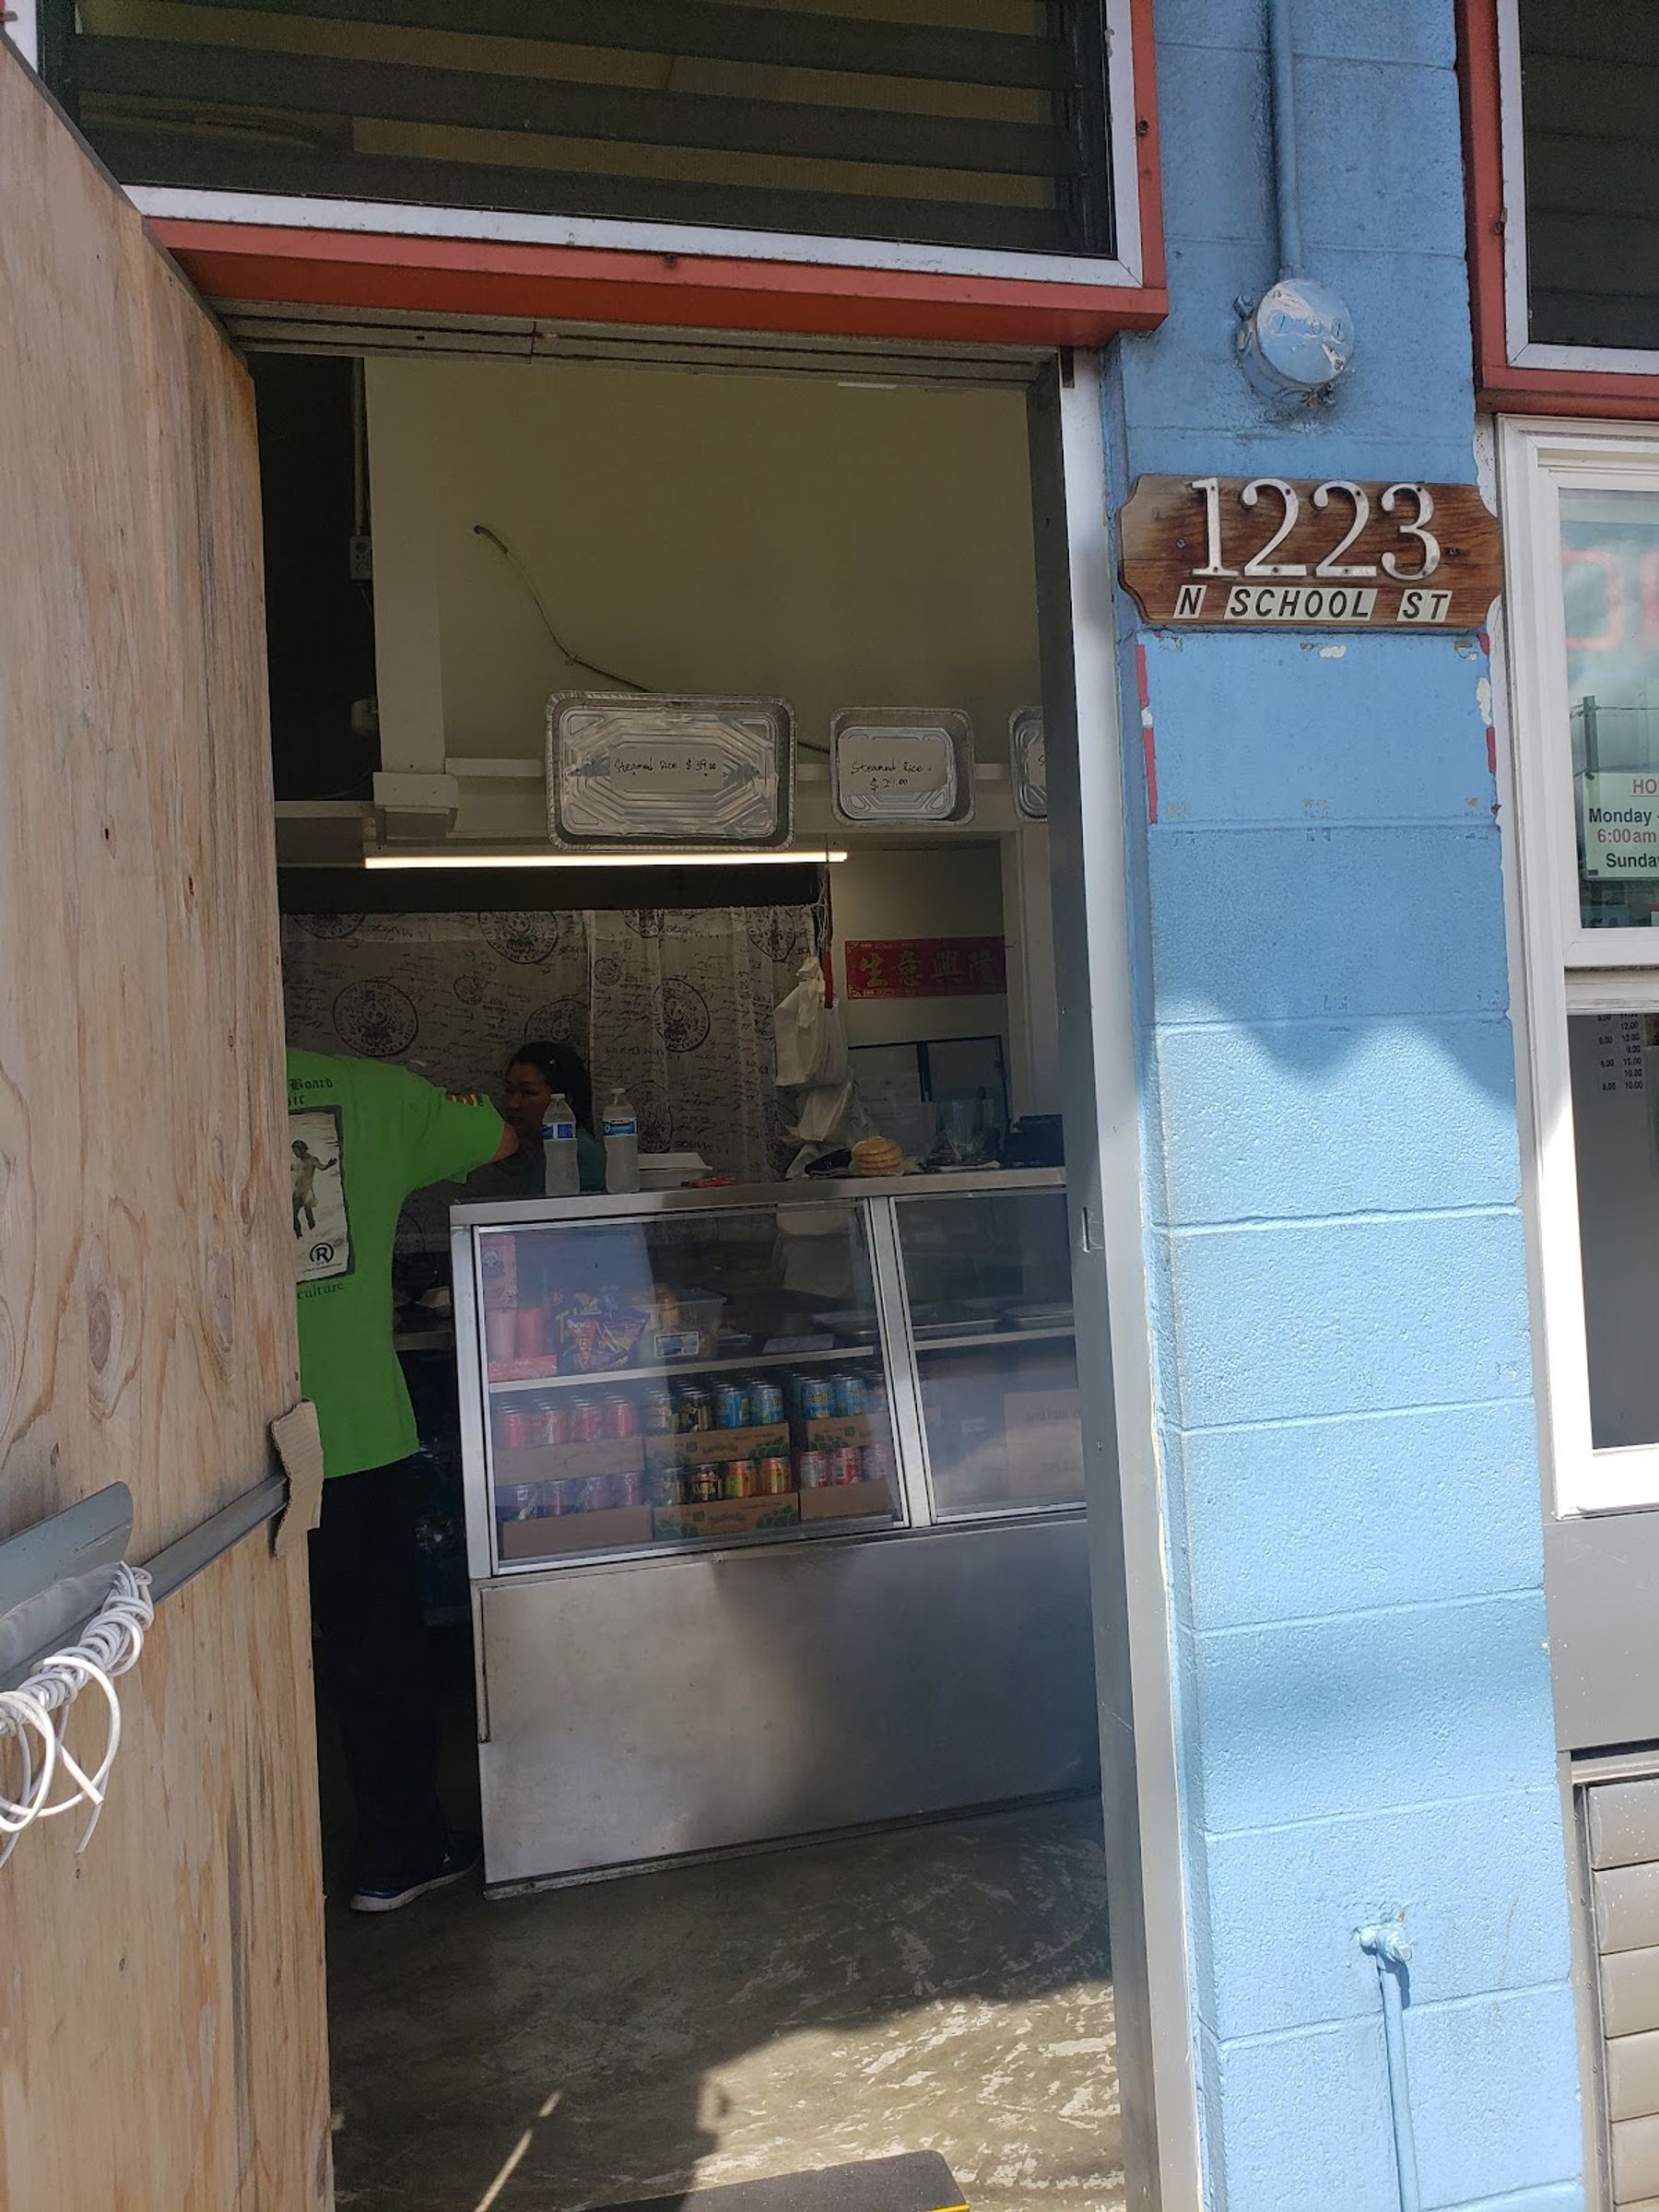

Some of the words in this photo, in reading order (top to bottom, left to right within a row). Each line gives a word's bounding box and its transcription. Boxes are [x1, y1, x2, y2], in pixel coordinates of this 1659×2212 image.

[1191, 477, 1441, 582] 1223
[1178, 587, 1203, 616] N
[1230, 589, 1370, 618] SCHOOL
[1402, 593, 1449, 620] ST
[1633, 779, 1659, 794] HO
[1589, 807, 1653, 827] Monday
